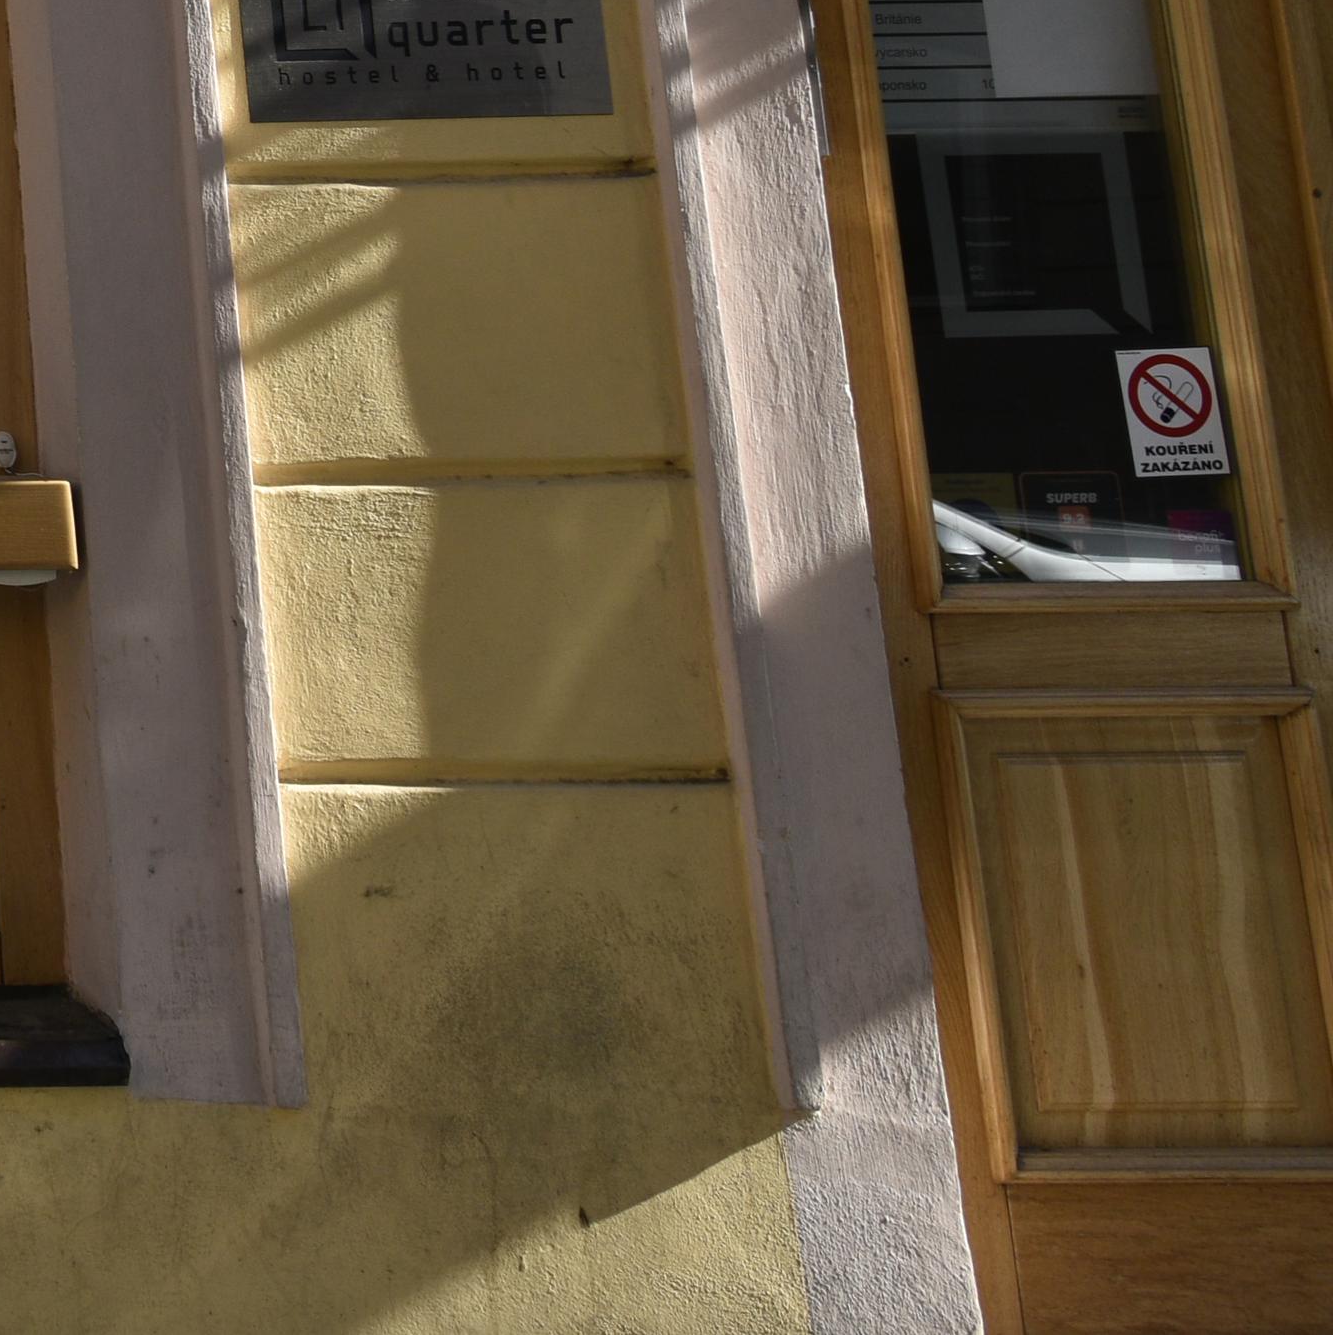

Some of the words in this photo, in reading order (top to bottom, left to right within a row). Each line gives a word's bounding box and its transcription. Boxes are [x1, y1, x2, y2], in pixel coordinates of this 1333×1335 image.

[388, 10, 573, 57] quarter
[278, 65, 399, 86] hostel
[425, 63, 440, 83] &
[467, 61, 566, 81] hotel
[1145, 441, 1214, 456] KOUŘENÍ
[1141, 458, 1223, 473] ZAKÁZÁNO
[1046, 493, 1097, 504] SUPERB
